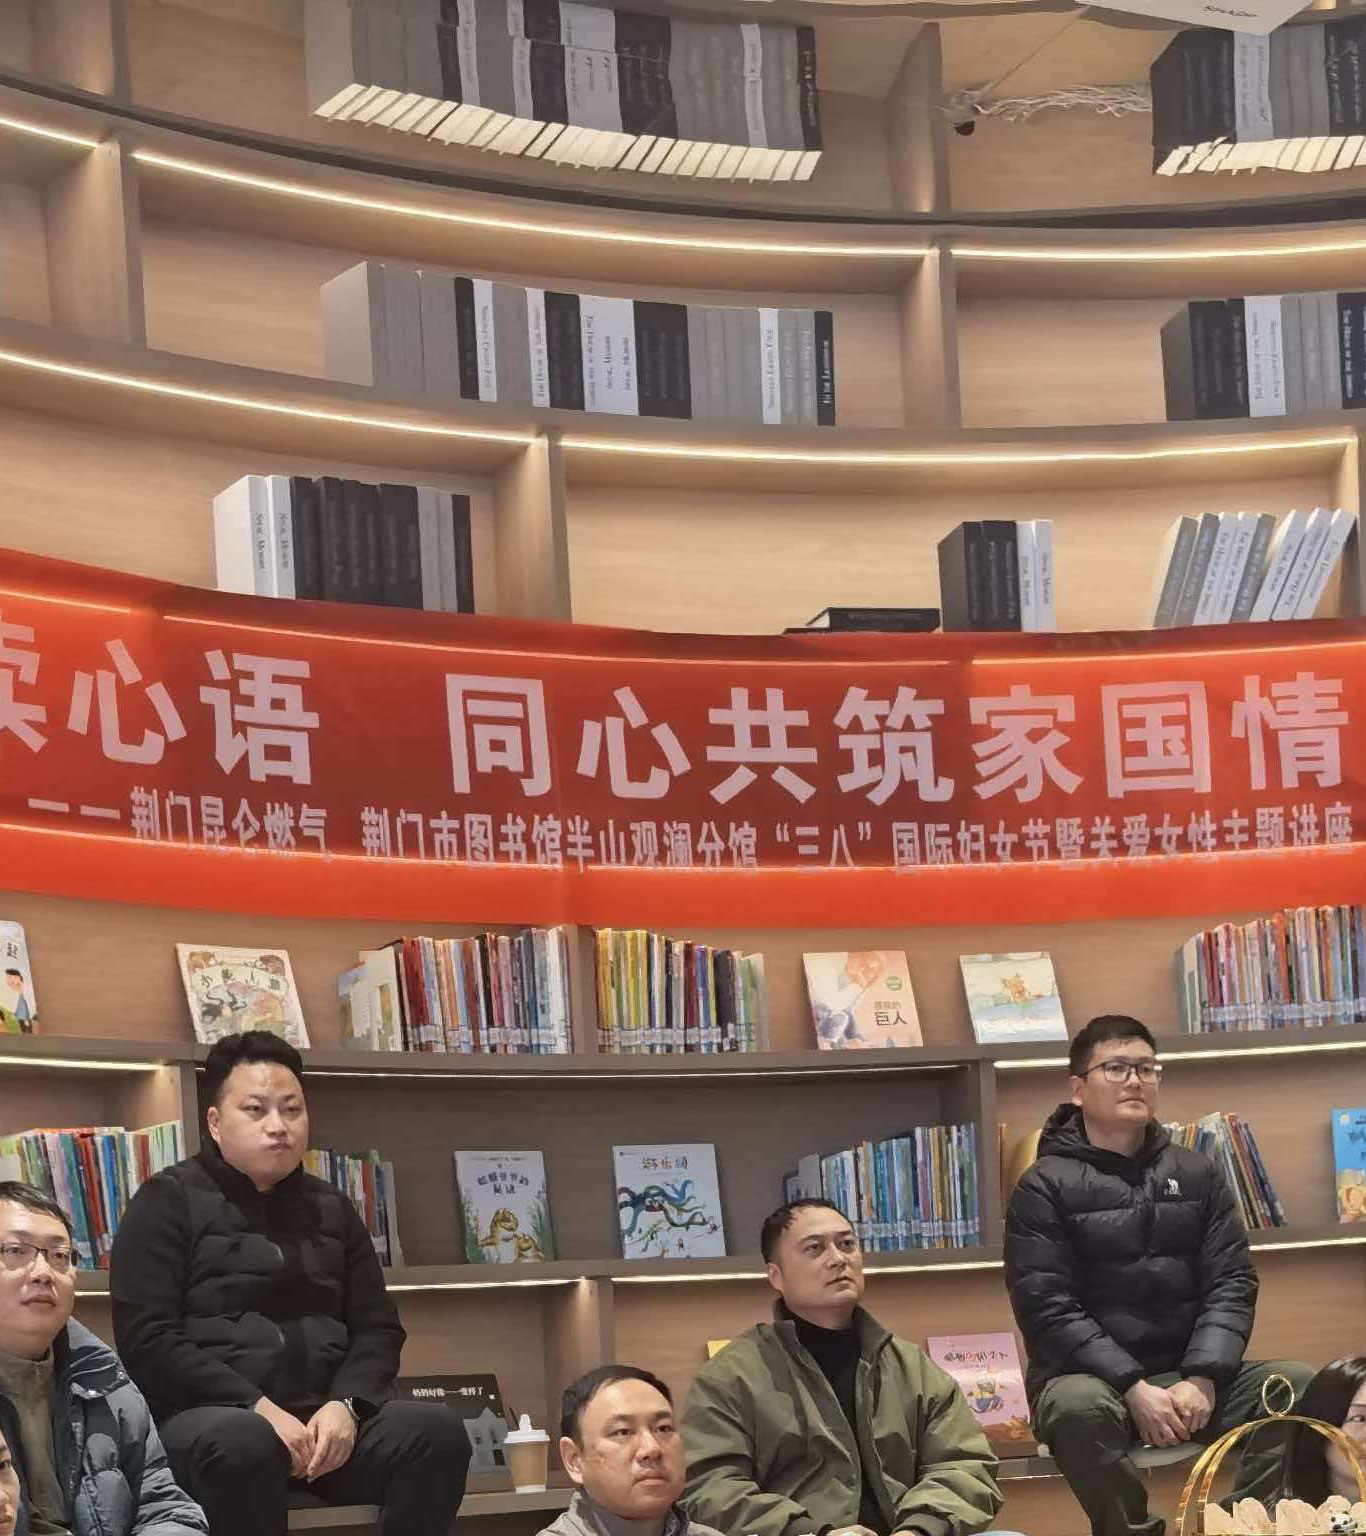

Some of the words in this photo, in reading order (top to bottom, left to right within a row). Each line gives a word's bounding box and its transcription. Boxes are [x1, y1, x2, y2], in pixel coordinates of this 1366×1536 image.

[445, 672, 1351, 806] 同心共筑家国情
[875, 1011, 907, 1026] 巨人
